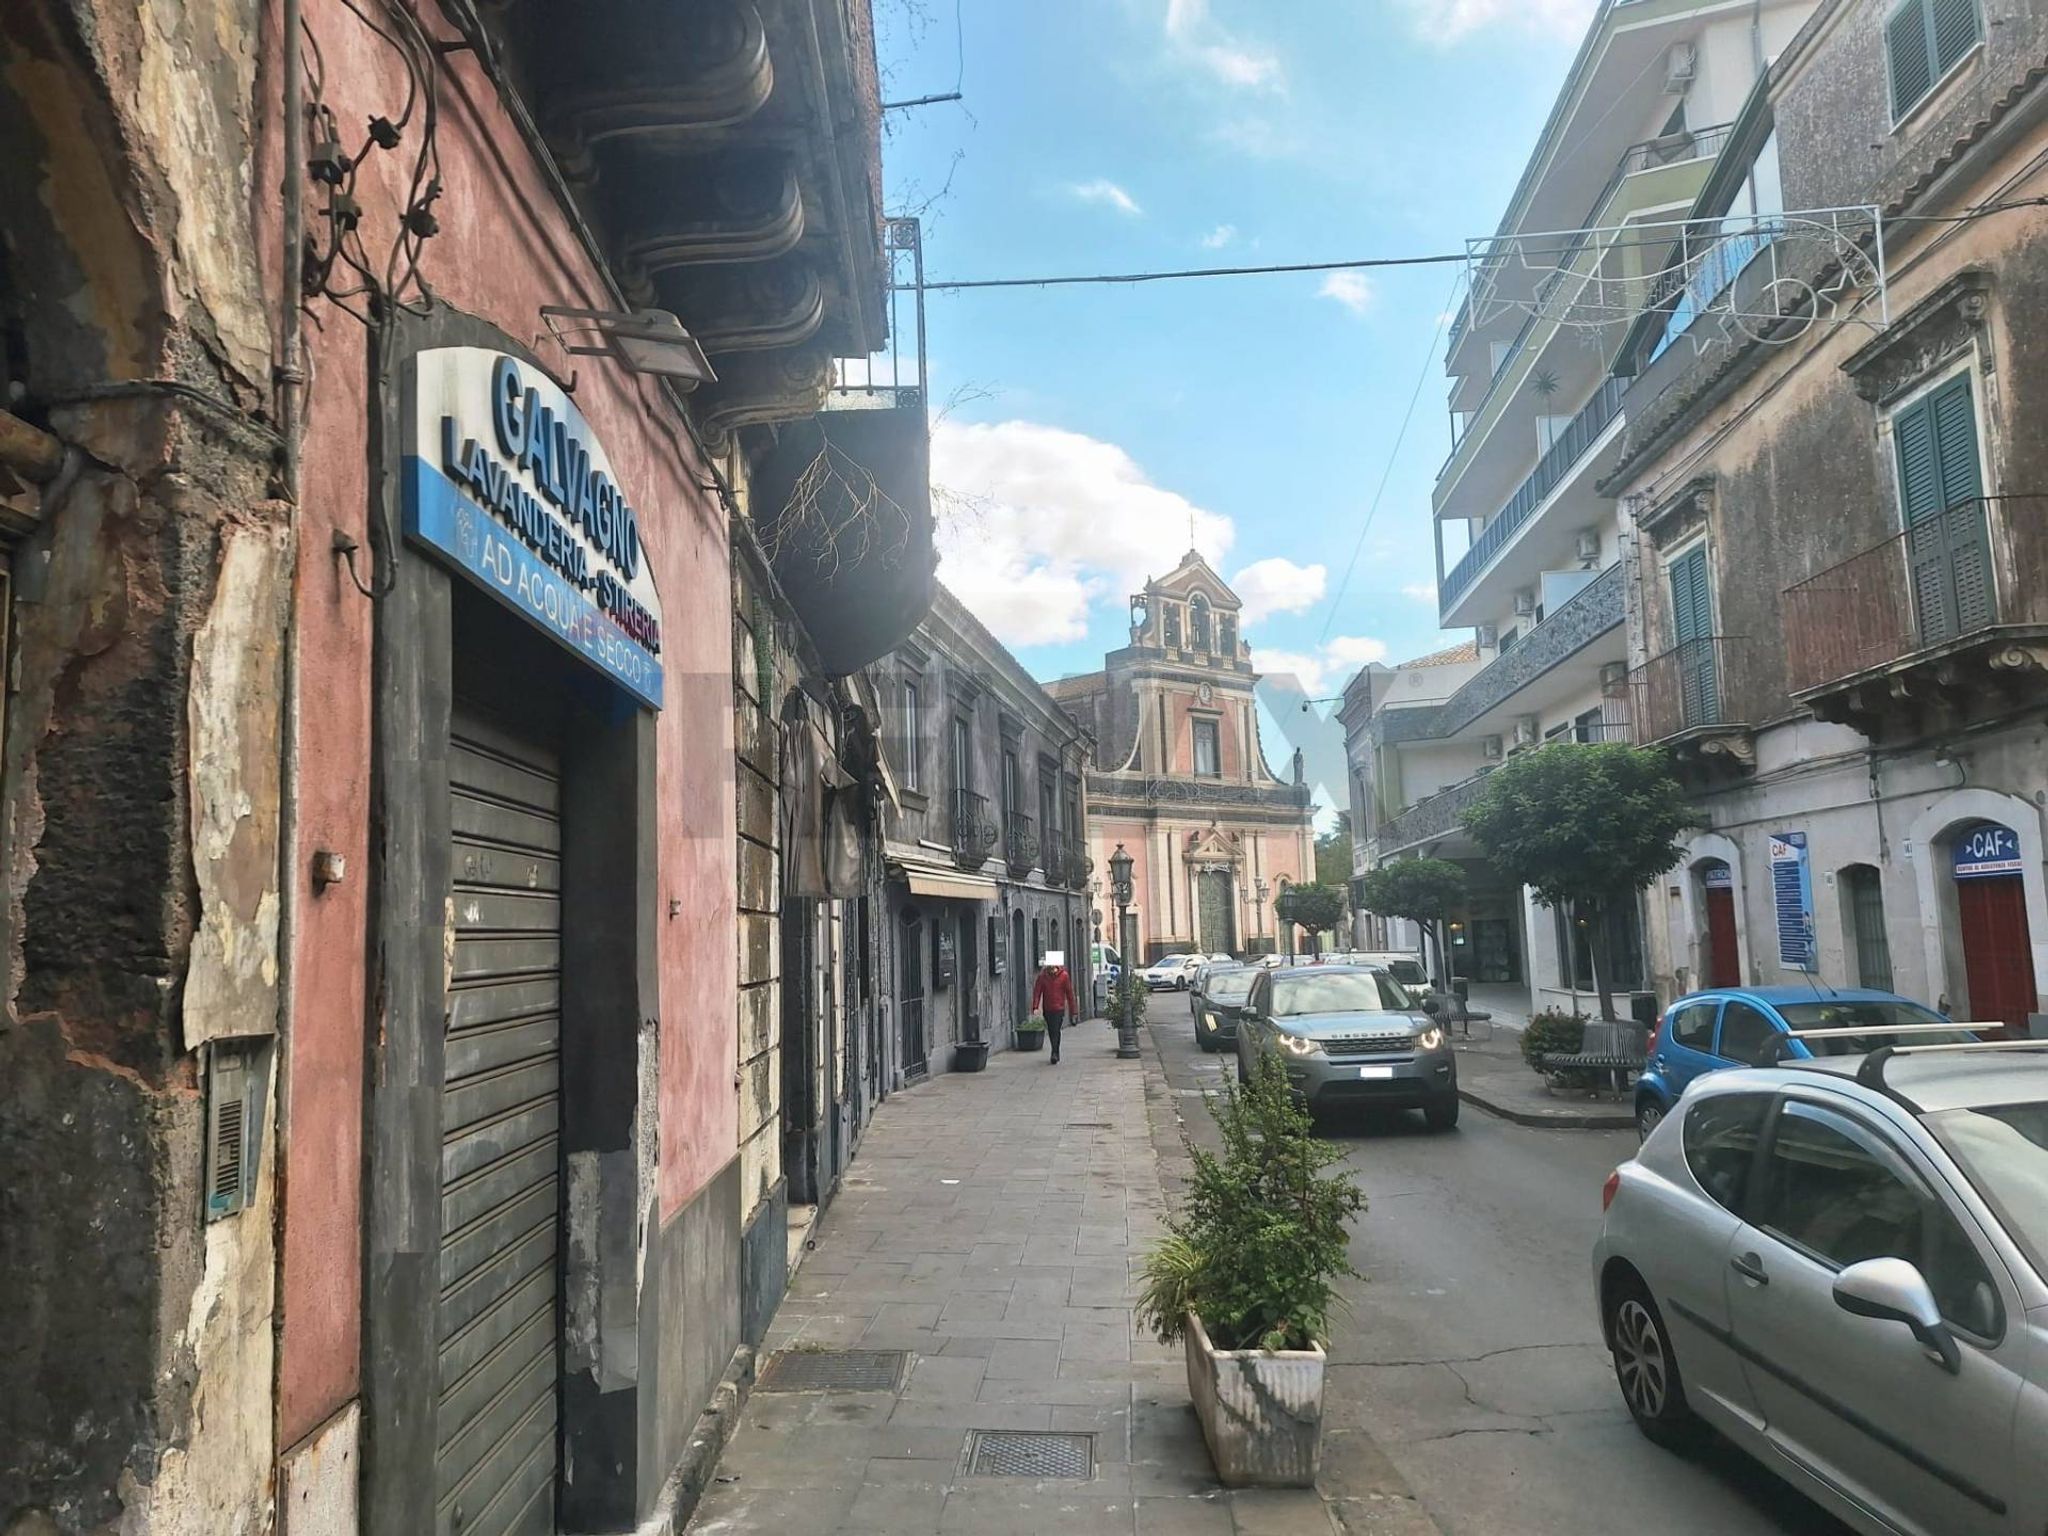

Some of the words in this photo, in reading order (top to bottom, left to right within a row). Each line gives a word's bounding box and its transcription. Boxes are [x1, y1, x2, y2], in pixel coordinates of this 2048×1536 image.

[441, 416, 590, 590] LAVANDERIA
[597, 570, 661, 654] STIRERIA
[492, 356, 639, 580] GALVAGNO
[482, 534, 513, 585] AD
[517, 562, 580, 639] ACQUA
[583, 615, 593, 648] E
[597, 626, 642, 684] SECCO
[1772, 843, 1788, 857] CAF
[1972, 830, 2003, 858] CAF
